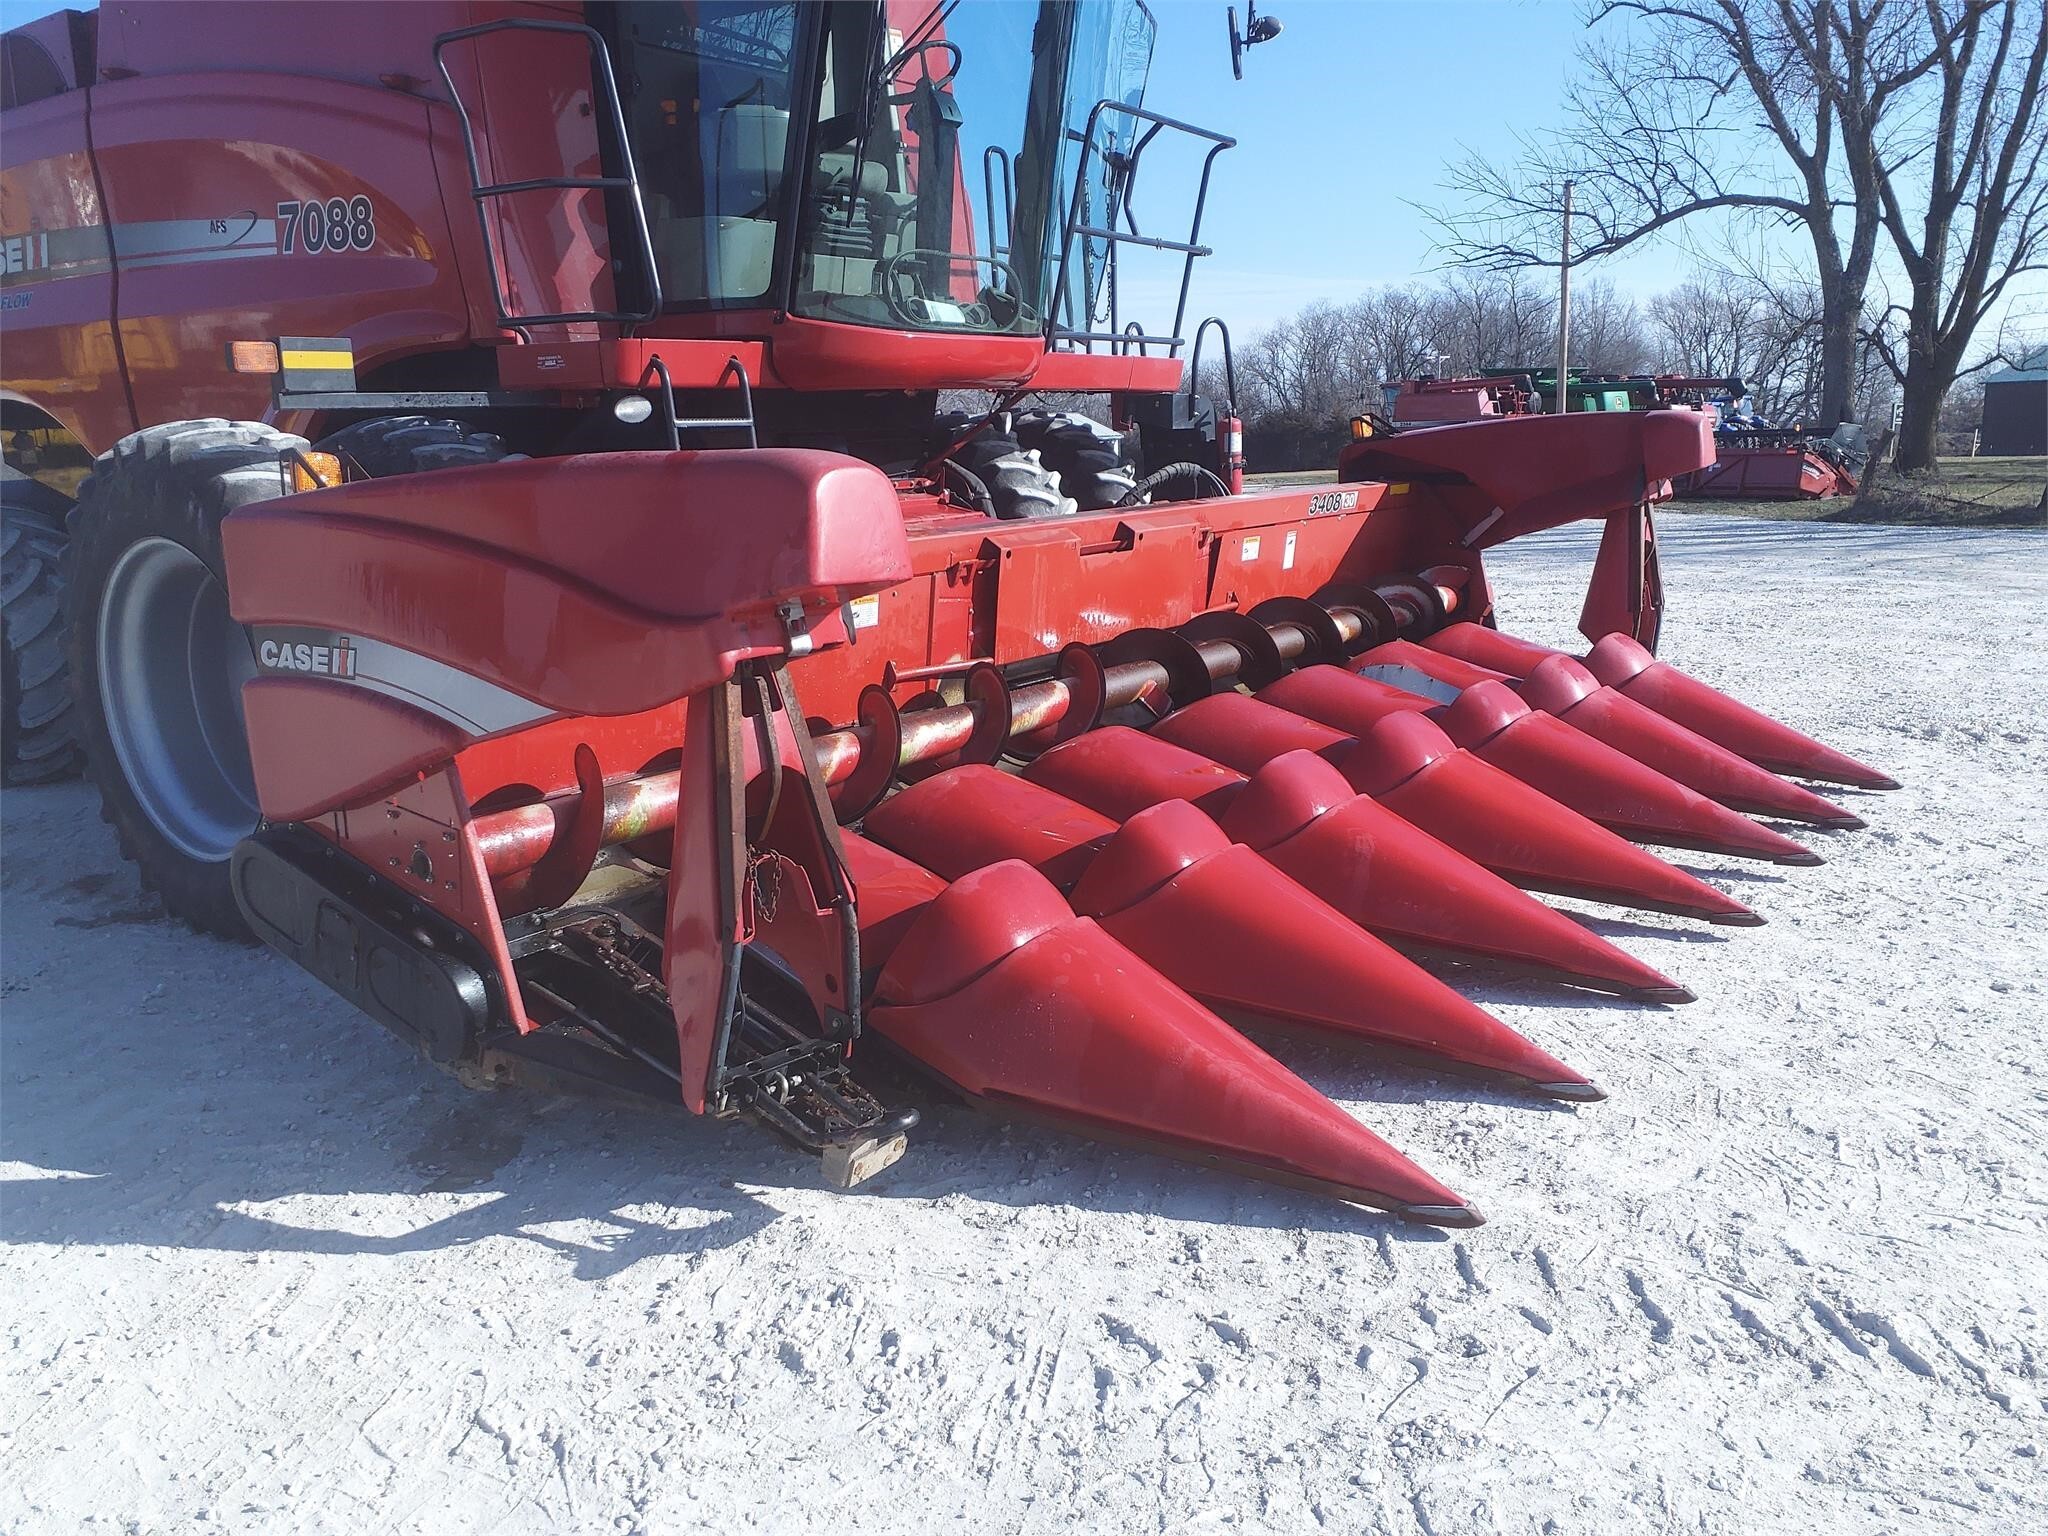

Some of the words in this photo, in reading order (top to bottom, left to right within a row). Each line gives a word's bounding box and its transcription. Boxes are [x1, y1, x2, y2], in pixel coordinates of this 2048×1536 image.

[209, 219, 228, 234] AFS
[276, 194, 376, 255] 7088
[1308, 491, 1343, 516] 3408
[260, 639, 330, 673] CASE
